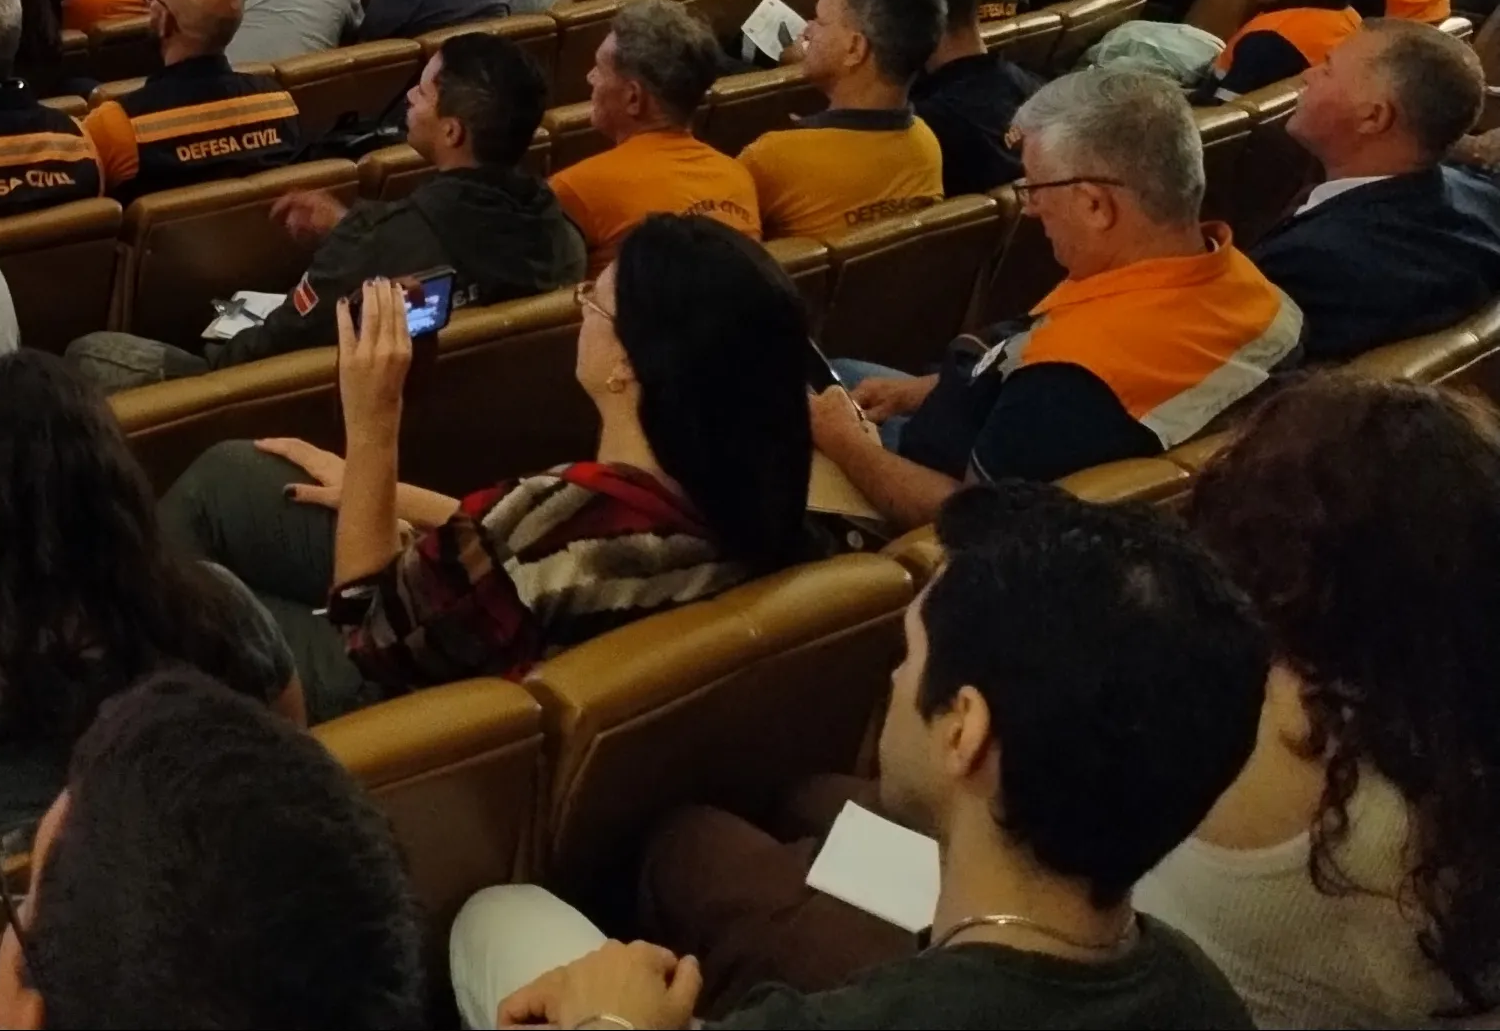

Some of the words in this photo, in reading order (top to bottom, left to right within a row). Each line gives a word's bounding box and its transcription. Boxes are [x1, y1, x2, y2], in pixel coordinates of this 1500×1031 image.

[176, 136, 242, 162] DEFESA
[242, 128, 282, 150] CIVIL
[25, 170, 76, 188] CIVIL
